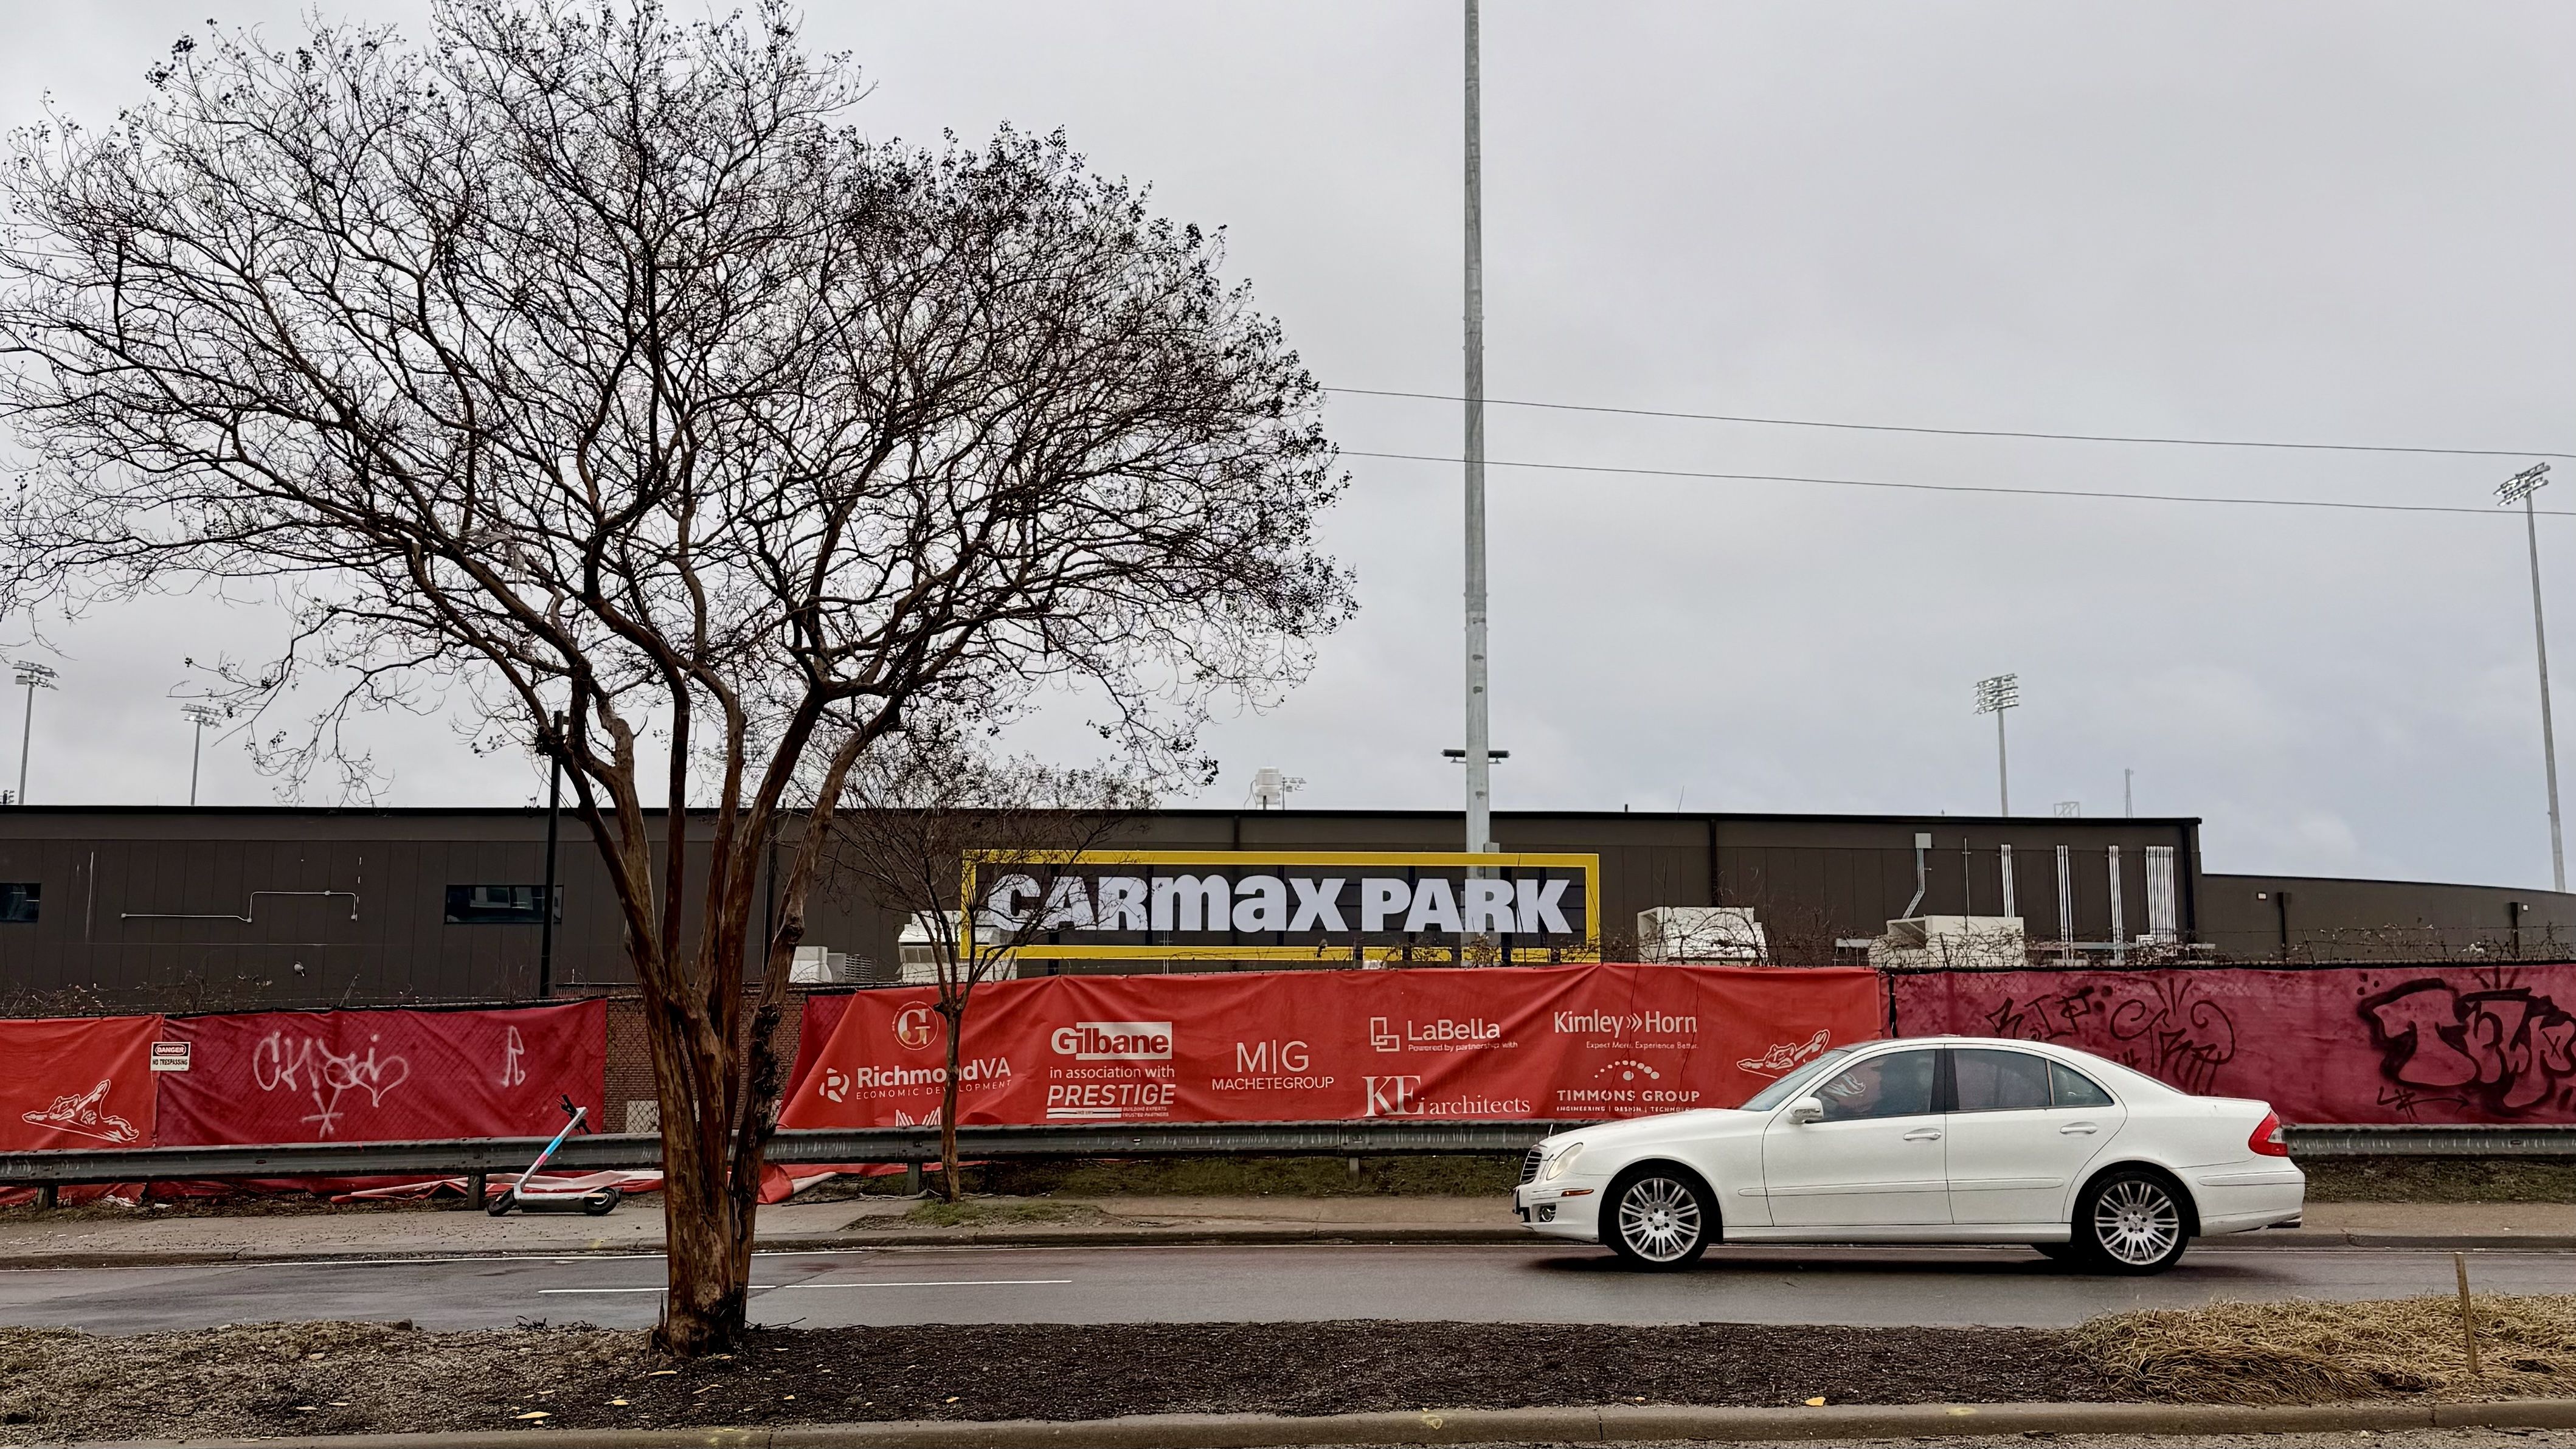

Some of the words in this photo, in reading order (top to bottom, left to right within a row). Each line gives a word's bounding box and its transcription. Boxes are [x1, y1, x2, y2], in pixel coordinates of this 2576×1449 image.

[1362, 877, 1573, 933] PARK
[1408, 1018, 1500, 1041] LaBella
[1051, 1027, 1169, 1055] Gilbane
[1586, 1041, 1610, 1050] Expect
[1635, 1041, 1675, 1050] Experience
[857, 1057, 1011, 1088] RichmodVA
[1050, 1067, 1062, 1079] in
[1065, 1065, 1141, 1079] association
[1144, 1064, 1175, 1078] with
[1211, 1076, 1334, 1090] MACHETEGROUP
[856, 1088, 919, 1100] ECONOMIC
[1047, 1084, 1176, 1106] PRESTIGE
[1557, 1090, 1636, 1102] TIMMONS
[1642, 1090, 1700, 1102] GROUP
[1429, 1095, 1531, 1115] architects
